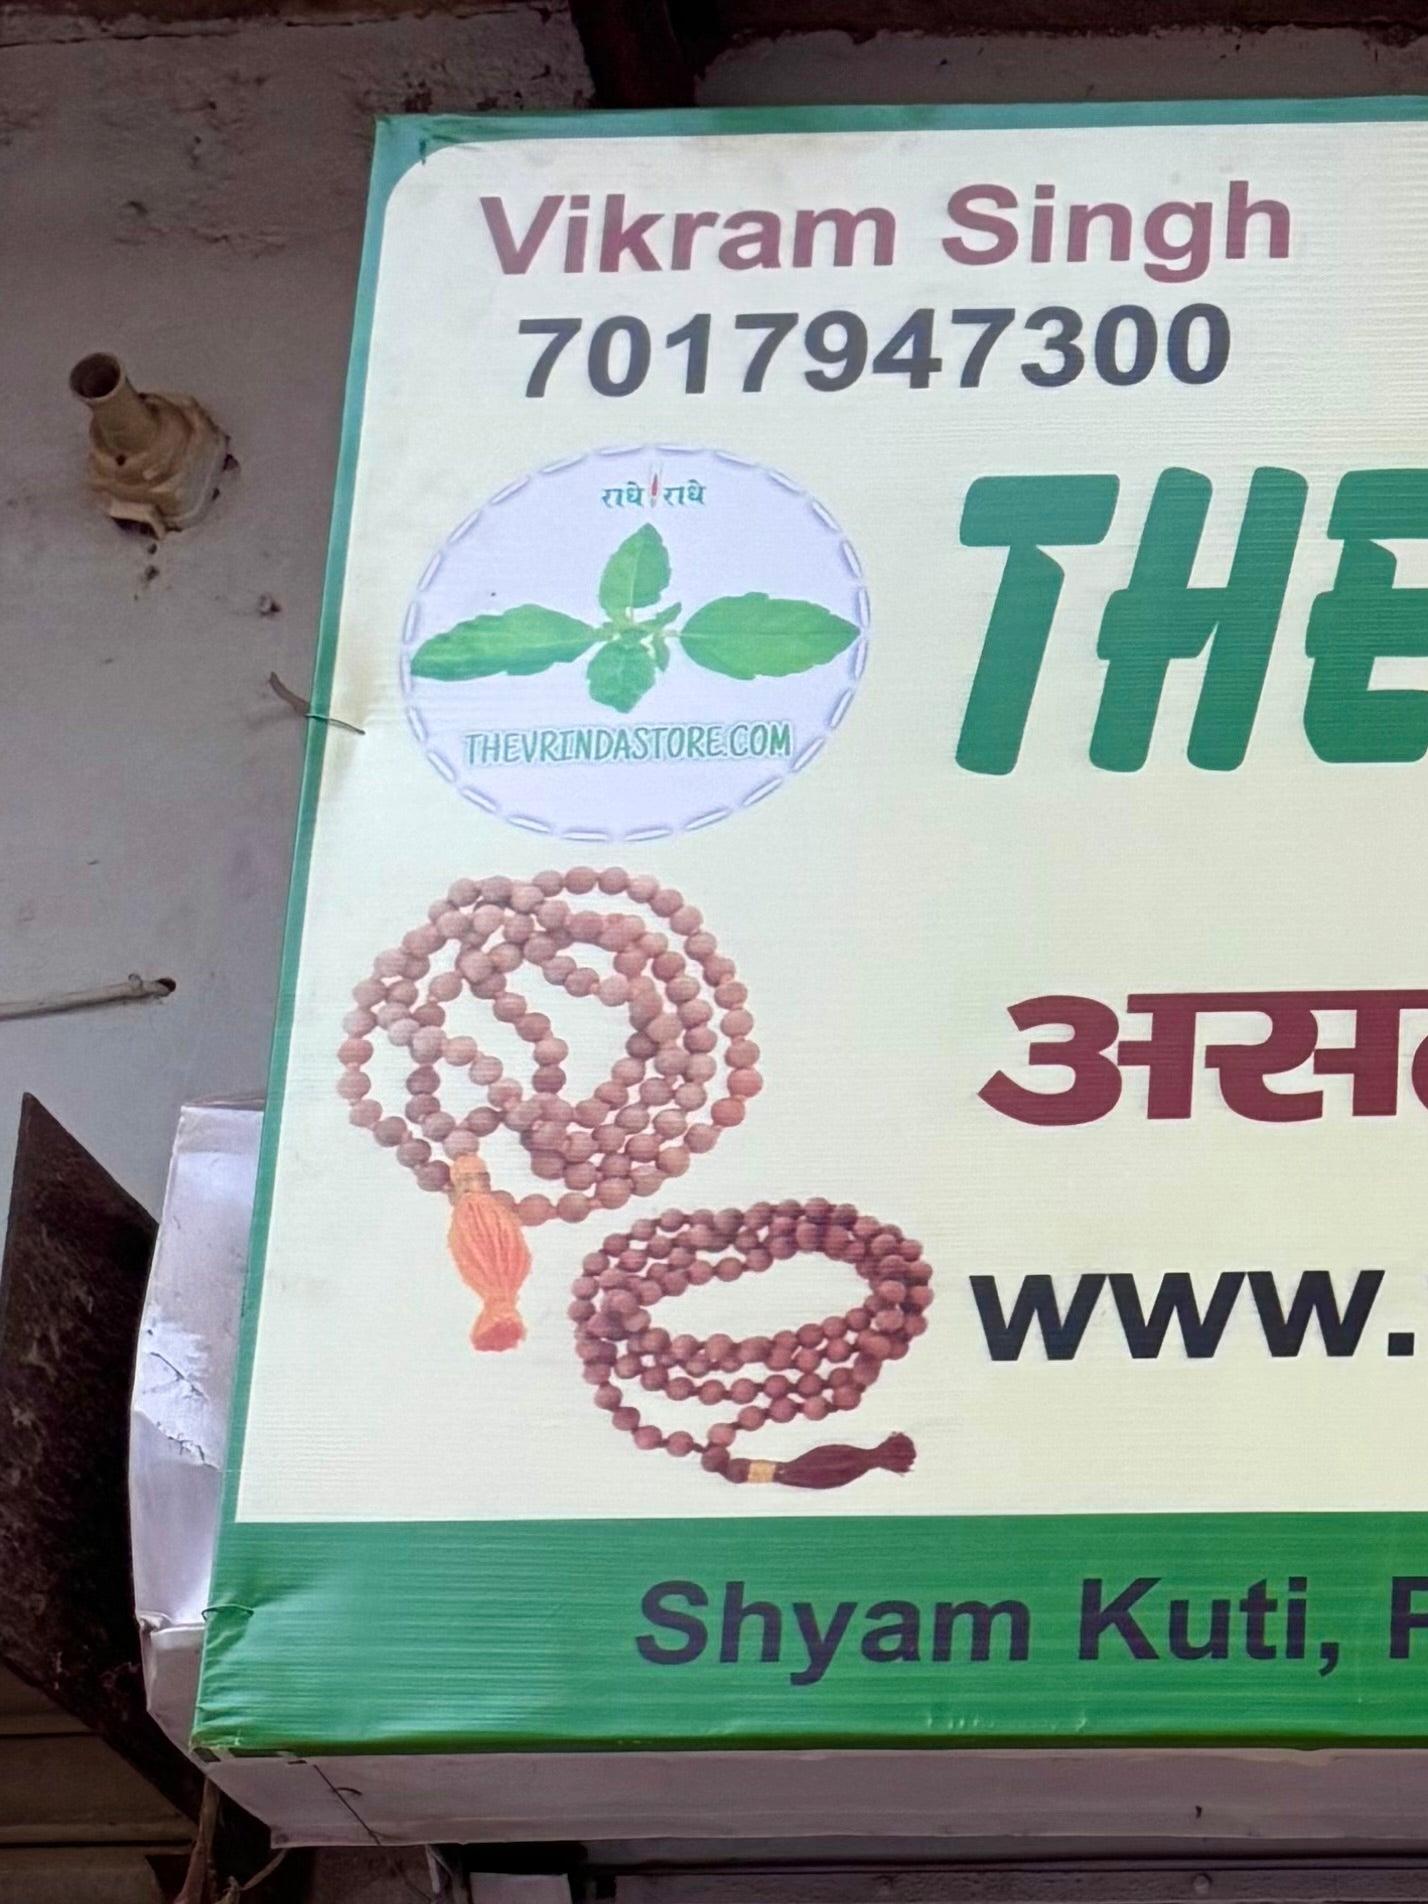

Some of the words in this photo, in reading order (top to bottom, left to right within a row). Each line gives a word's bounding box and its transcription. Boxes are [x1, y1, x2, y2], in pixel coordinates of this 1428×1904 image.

[480, 194, 895, 274] Vikram
[942, 181, 1290, 283] Singh
[519, 303, 1230, 397] 7017947300
[602, 481, 645, 508] राधे
[664, 479, 706, 506] राधे
[465, 723, 791, 767] THEVRINDASTORE.COM
[637, 1582, 1029, 1687] Shyam
[1080, 1578, 1337, 1674] Kuti,
